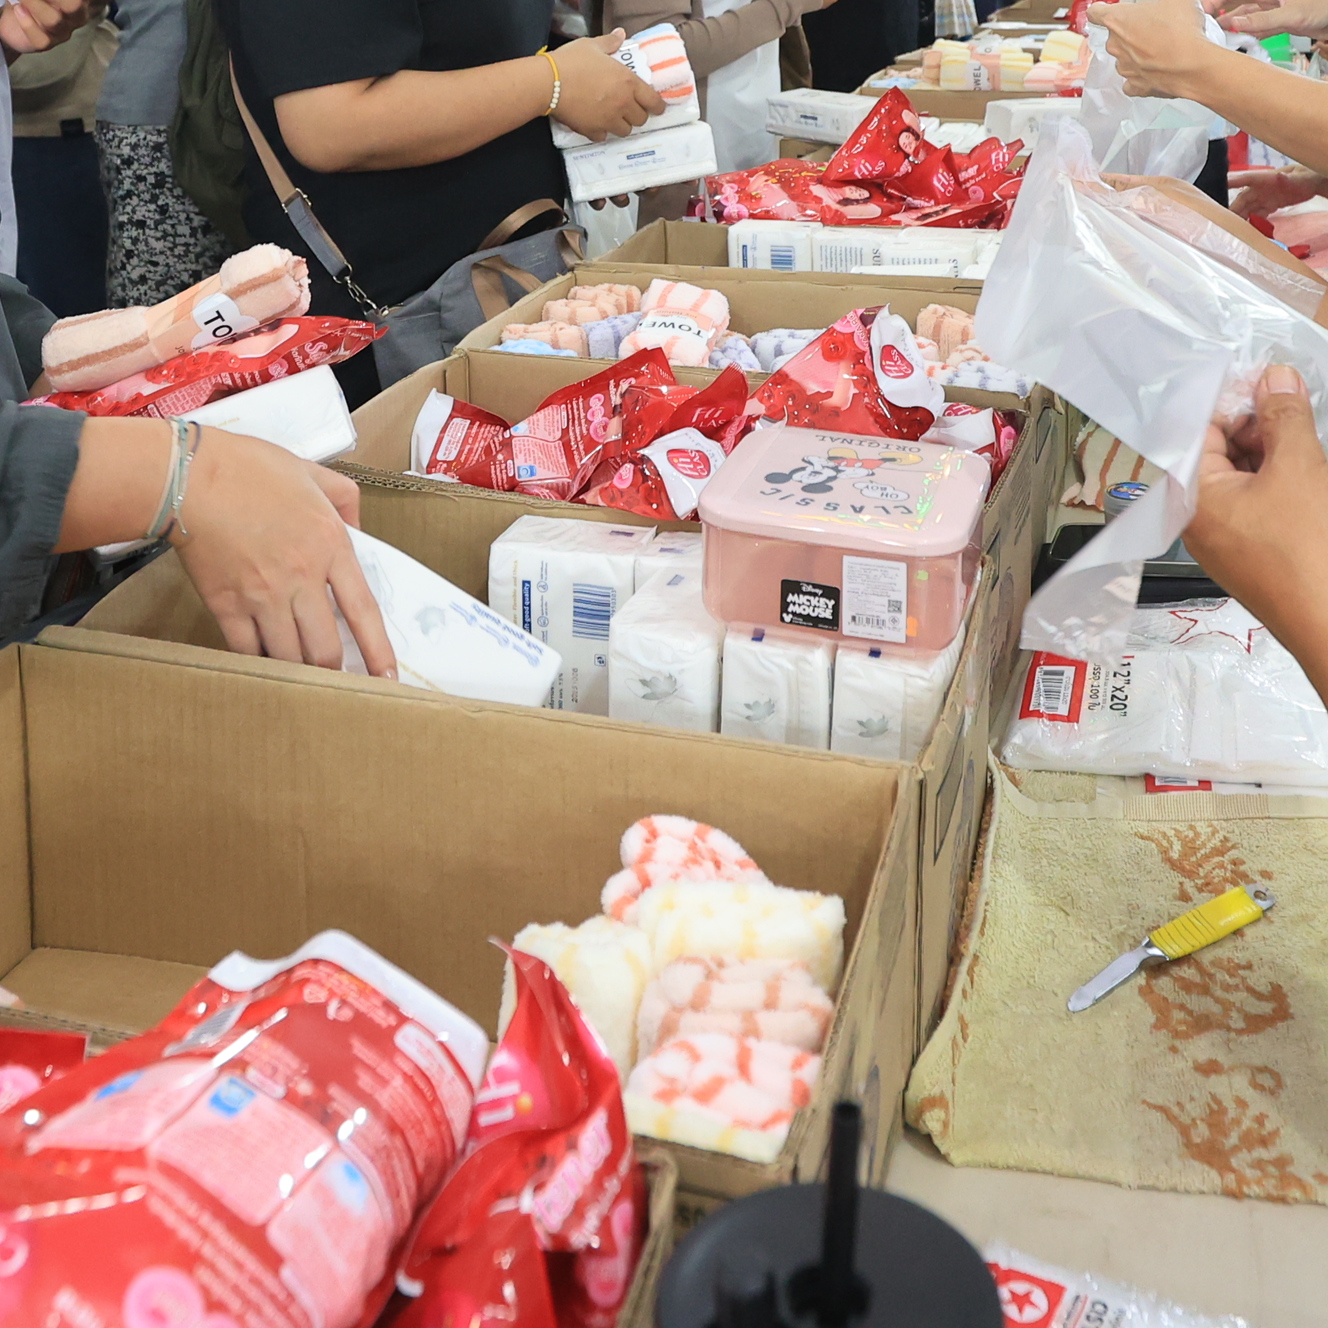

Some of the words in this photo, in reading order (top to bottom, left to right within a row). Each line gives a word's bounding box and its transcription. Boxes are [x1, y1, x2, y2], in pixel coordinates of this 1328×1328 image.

[203, 310, 239, 339] TO
[639, 320, 704, 339] TOWE
[815, 433, 922, 453] ORIGINAL
[759, 487, 914, 516] CLASSIC
[522, 582, 531, 605] quality
[800, 583, 823, 596] Disney
[786, 593, 836, 610] MICKEY
[522, 605, 531, 633] oft-good
[787, 603, 833, 620] MOUSE
[1089, 684, 1100, 700] 100
